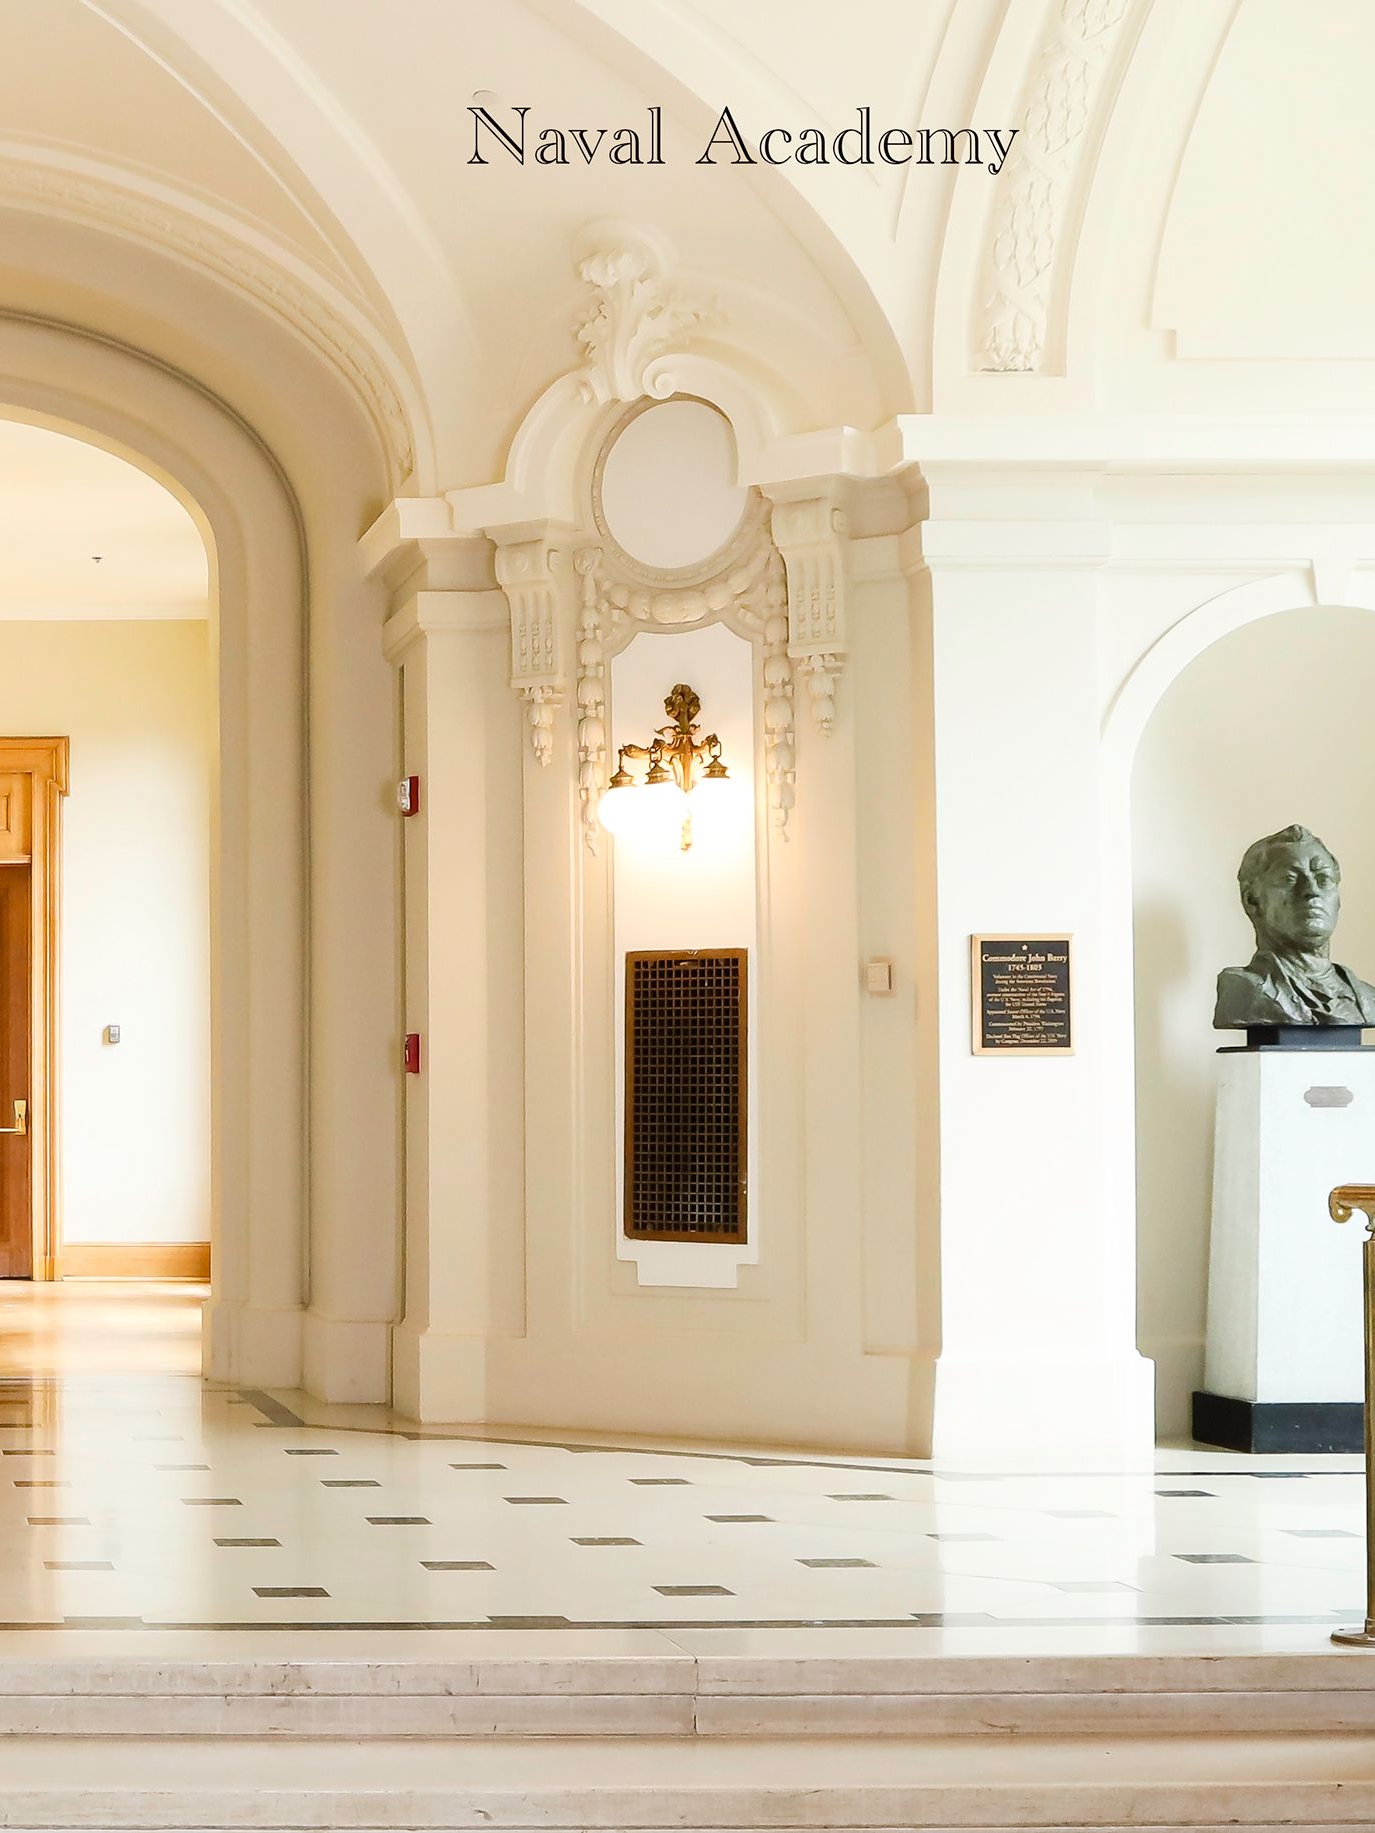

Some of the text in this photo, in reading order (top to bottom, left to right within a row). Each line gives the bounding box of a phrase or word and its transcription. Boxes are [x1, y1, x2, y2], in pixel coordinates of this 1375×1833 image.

[982, 953, 1068, 964] Commodore John Barry
